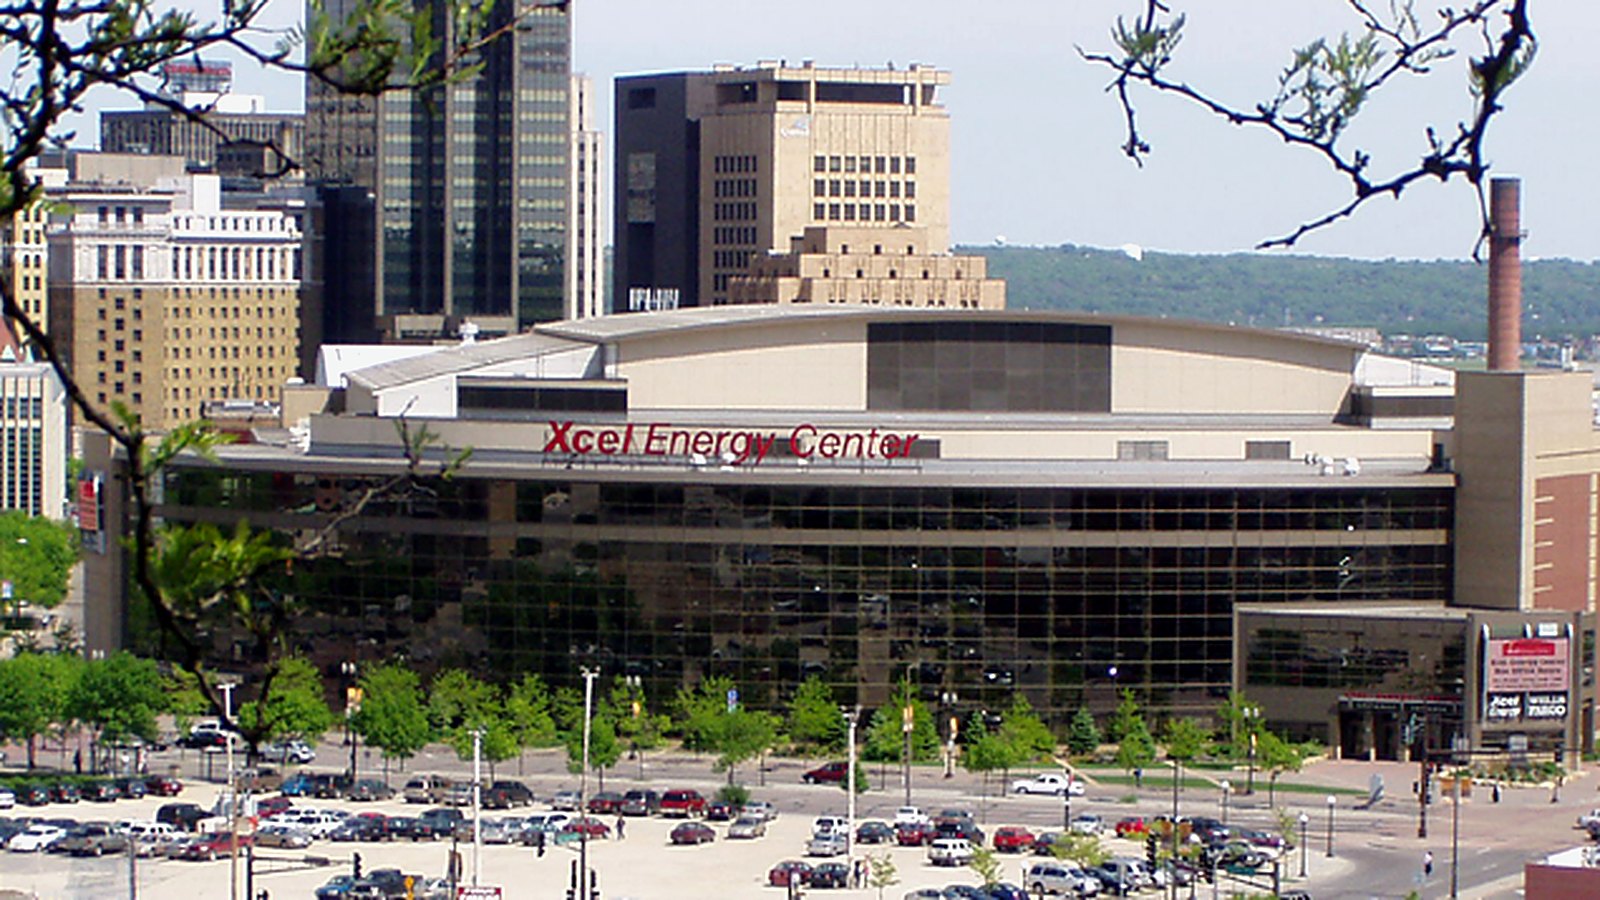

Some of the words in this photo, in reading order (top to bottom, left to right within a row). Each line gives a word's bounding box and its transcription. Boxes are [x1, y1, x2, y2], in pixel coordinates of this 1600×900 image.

[543, 420, 634, 455] Xcel
[644, 423, 776, 466] Energy
[789, 424, 919, 460] Center
